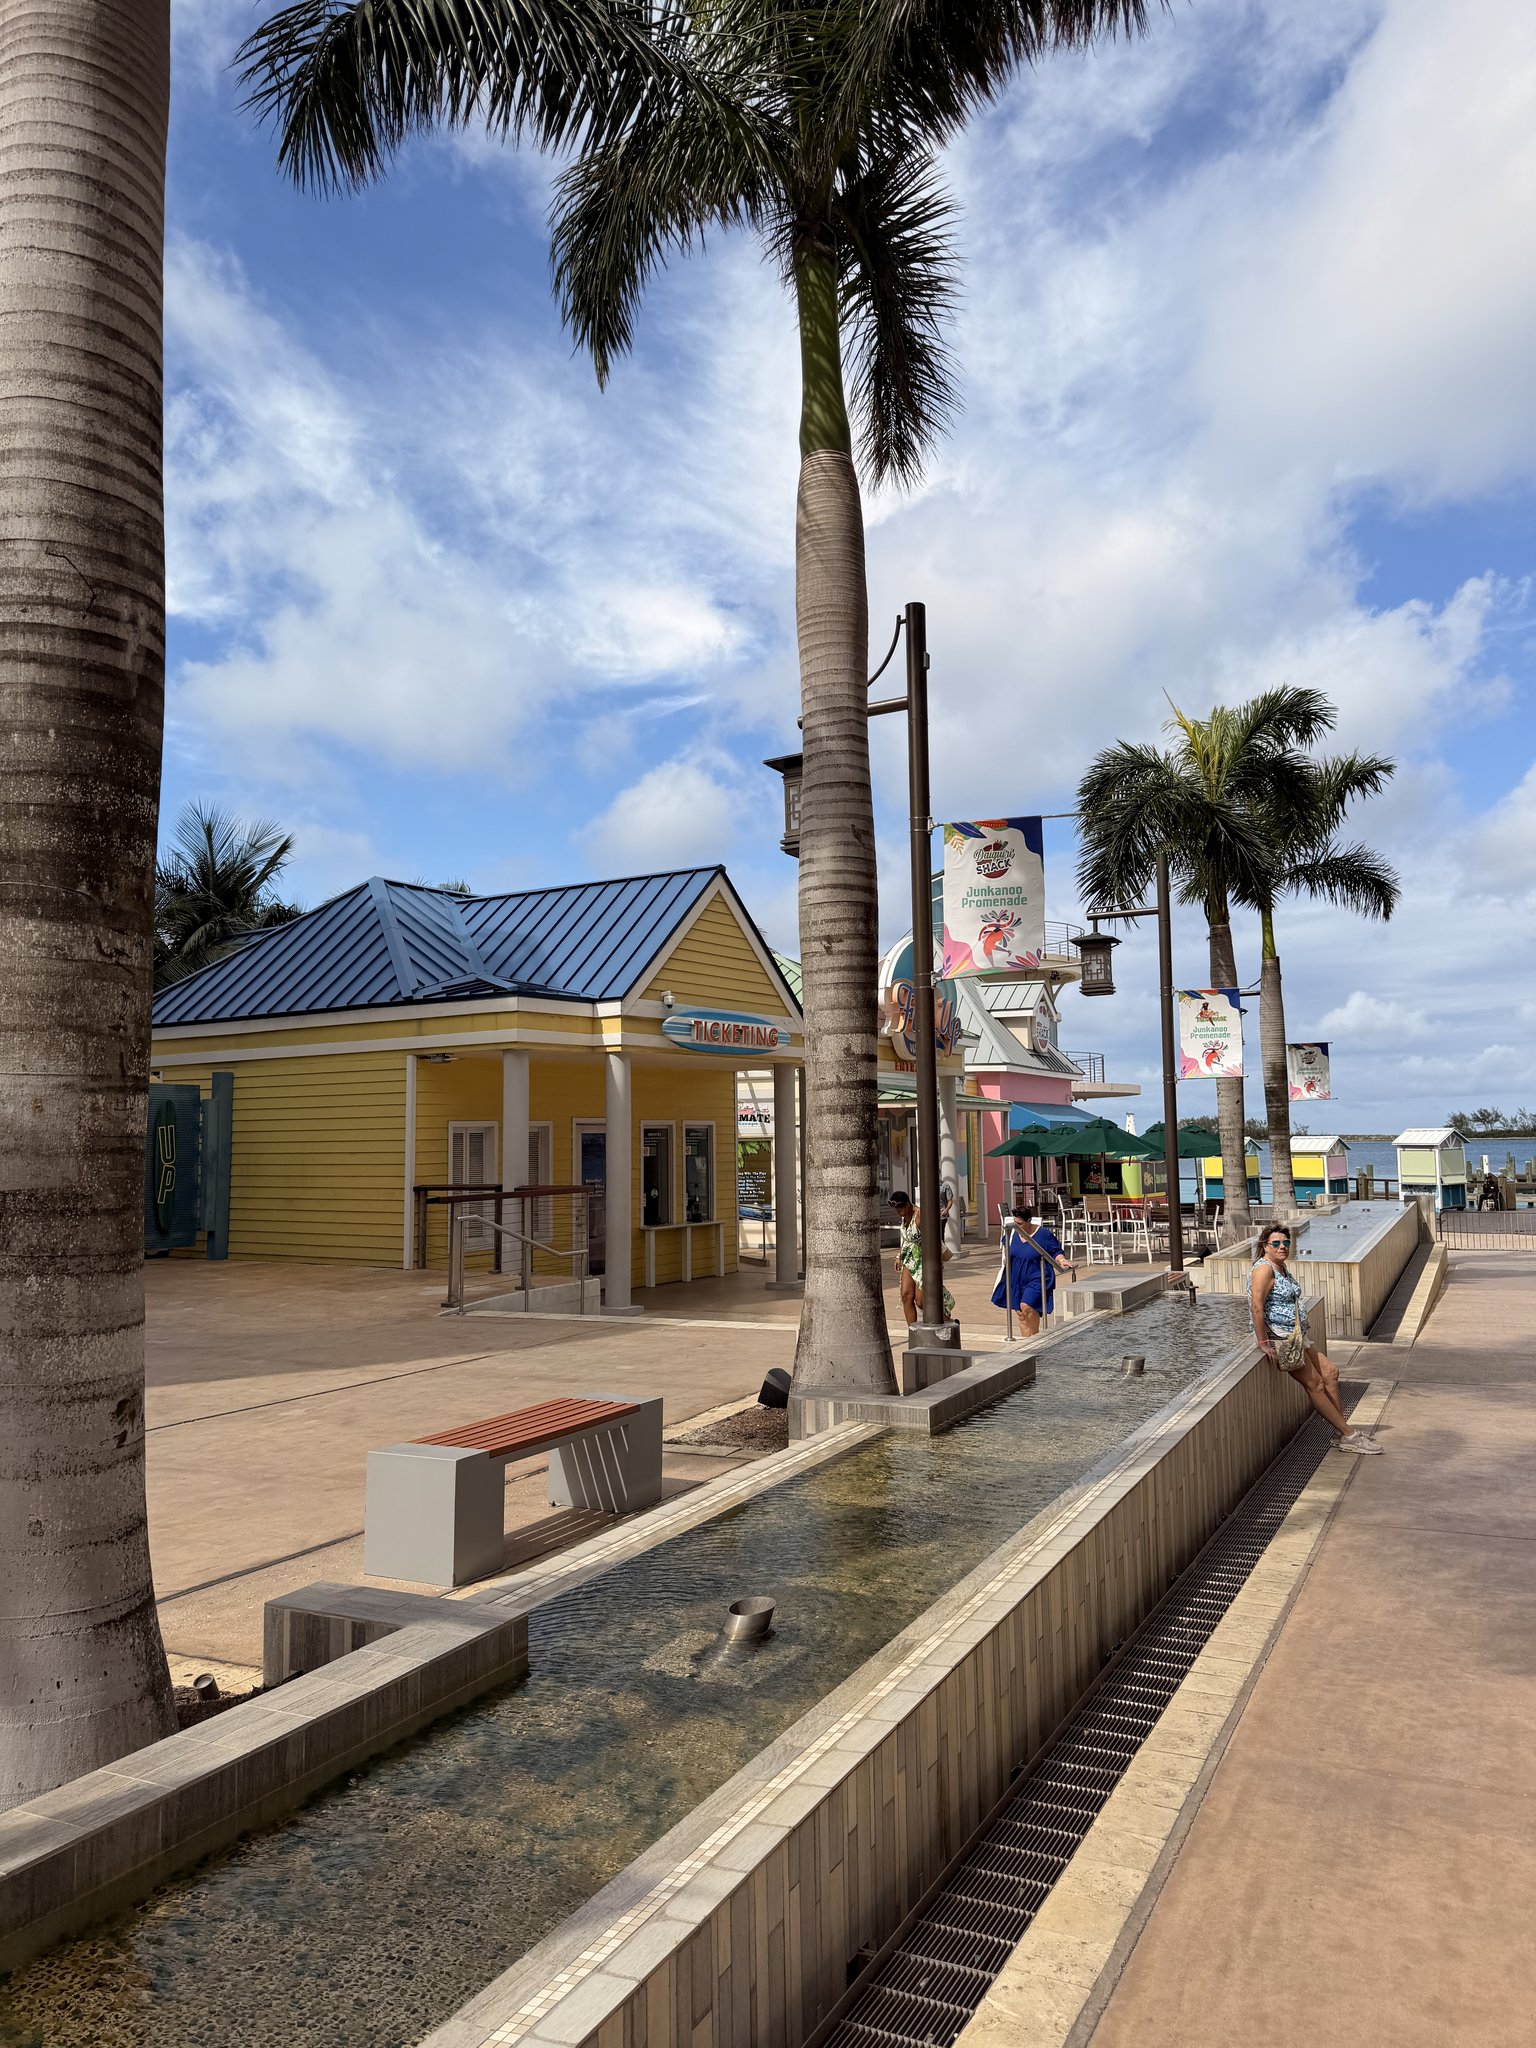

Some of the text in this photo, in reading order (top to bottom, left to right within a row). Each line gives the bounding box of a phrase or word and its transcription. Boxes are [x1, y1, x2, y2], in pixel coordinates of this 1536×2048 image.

[976, 859, 1012, 874] SHACK
[966, 886, 1022, 897] Junkanoo
[961, 895, 1028, 908] Promenade
[693, 1020, 779, 1047] TICKETING
[157, 1124, 177, 1204] UP
